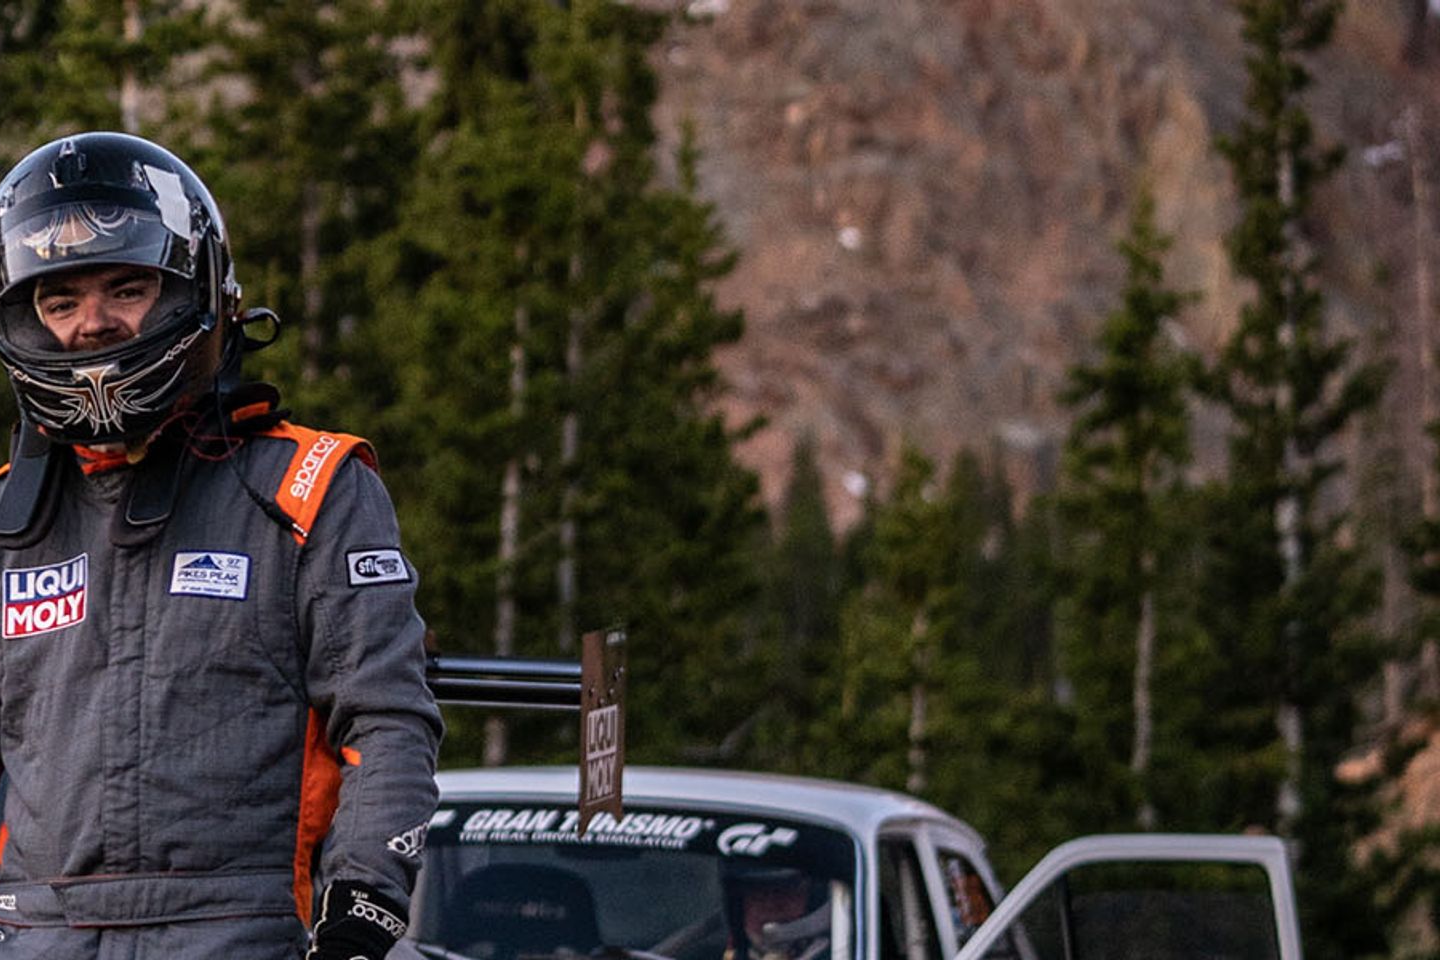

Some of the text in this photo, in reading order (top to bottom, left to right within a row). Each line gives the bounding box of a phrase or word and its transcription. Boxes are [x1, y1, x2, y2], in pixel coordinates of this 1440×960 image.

[289, 435, 336, 500] sparco
[9, 559, 85, 601] LIQUI
[6, 590, 84, 635] MOLY
[462, 809, 561, 831] GRAN
